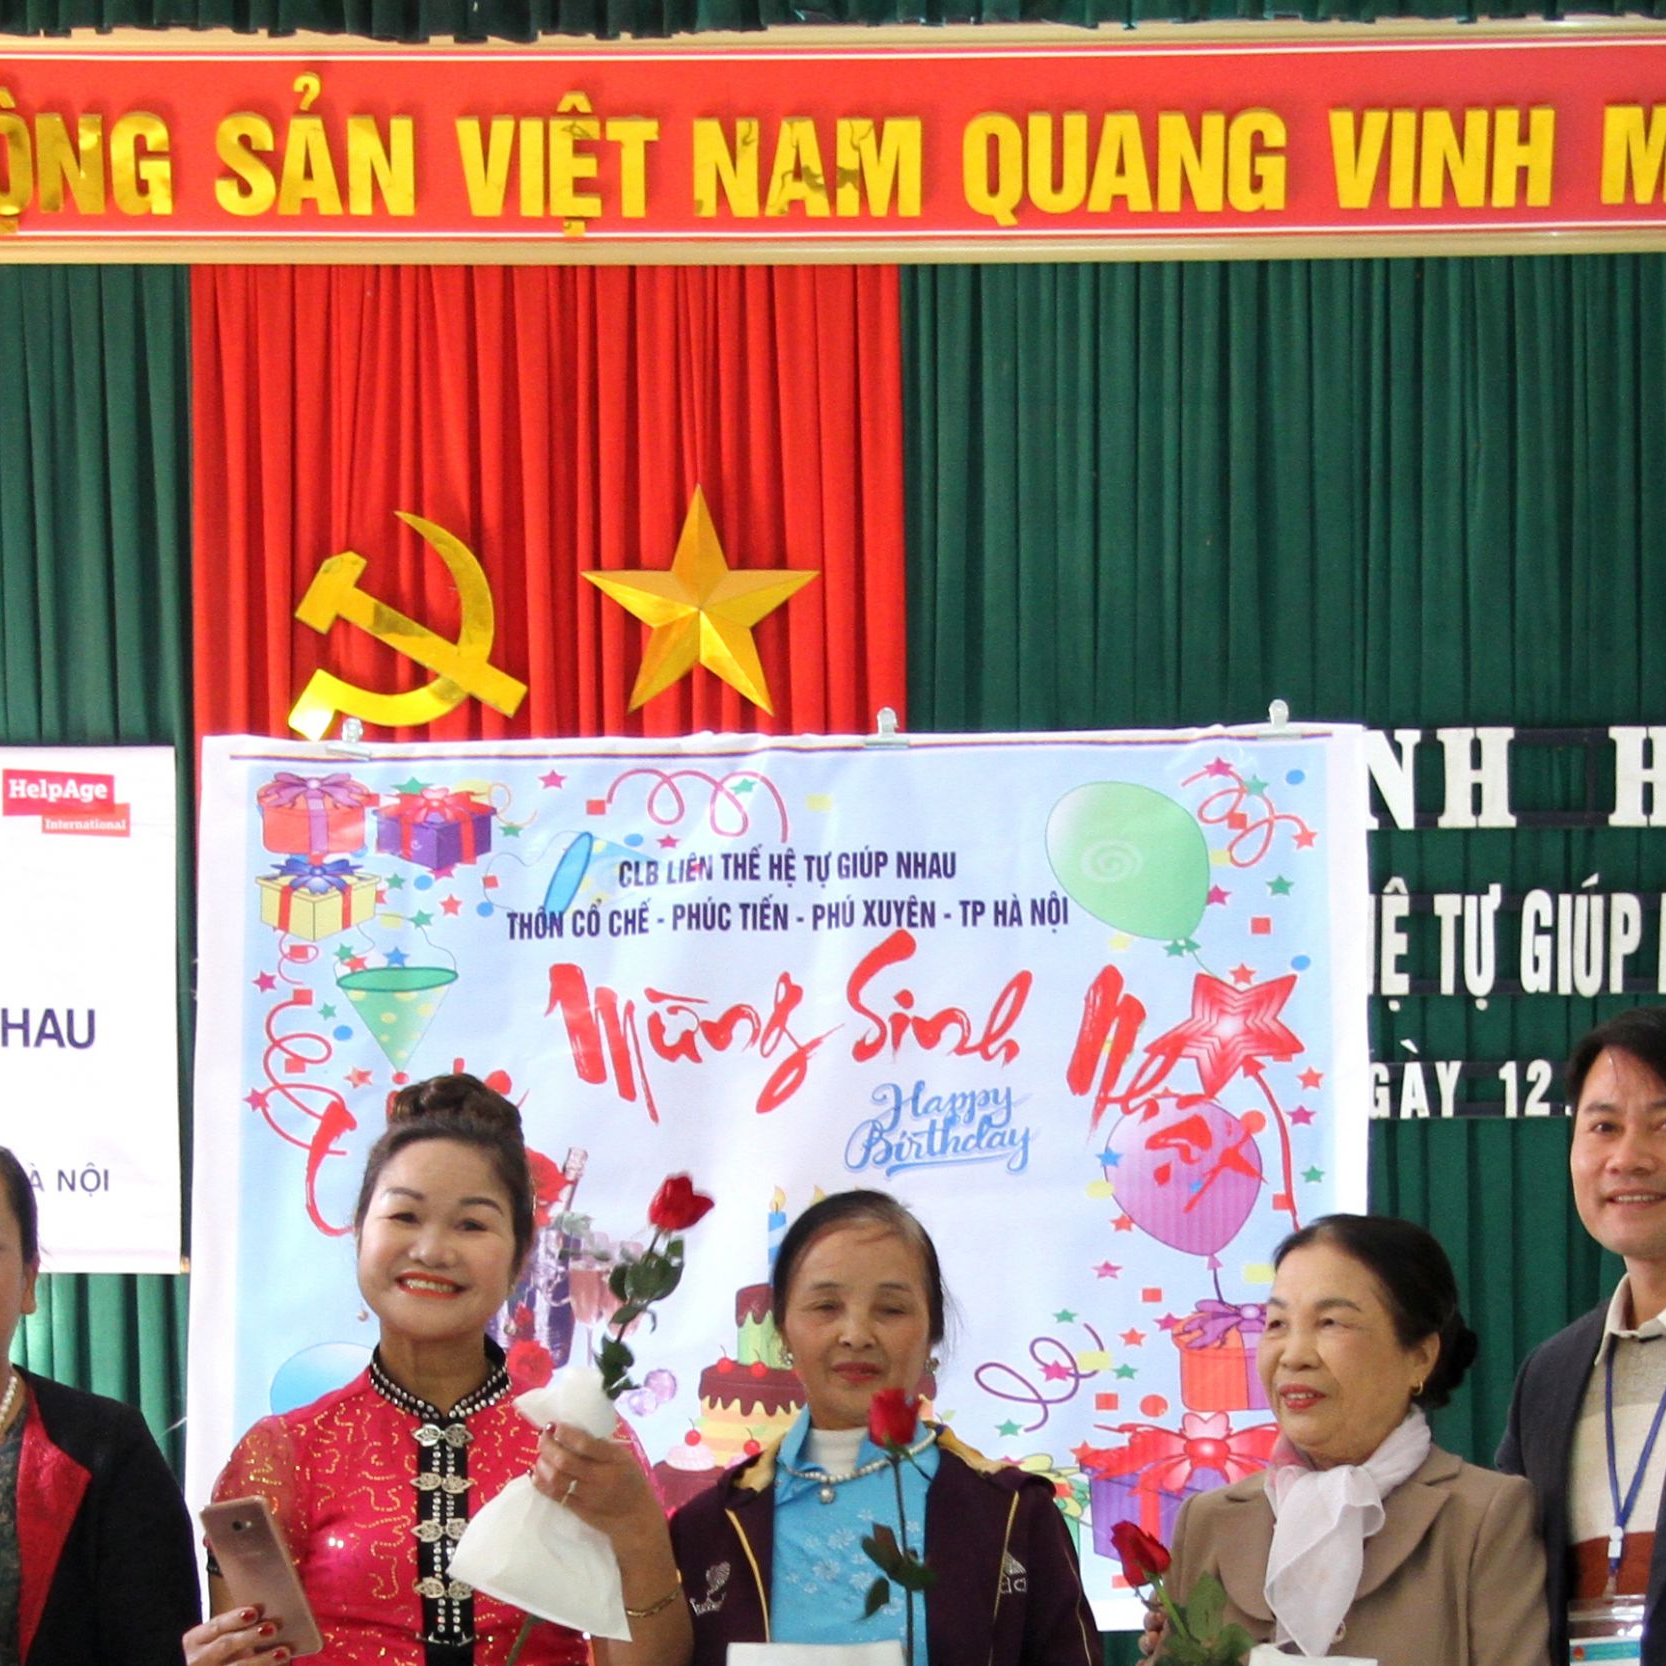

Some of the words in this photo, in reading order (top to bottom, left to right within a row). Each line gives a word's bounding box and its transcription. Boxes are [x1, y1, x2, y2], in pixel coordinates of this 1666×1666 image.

[214, 71, 416, 217] SẢN
[454, 90, 660, 236] VIỆT
[693, 115, 923, 218] NAM
[962, 107, 1287, 226] QUANG
[1328, 105, 1555, 209] VINH
[8, 778, 109, 802] HelpAge
[1363, 726, 1518, 830] NH
[44, 818, 128, 832] International
[618, 859, 659, 888] CLB
[666, 856, 713, 885] LIÊN
[720, 843, 763, 881] THẾ
[768, 849, 797, 888] HỆ
[804, 851, 834, 889] TỰ
[837, 844, 888, 880] GIÚP
[896, 851, 957, 880] NHAU
[507, 905, 564, 941] THÔN
[571, 897, 604, 938] CỔ
[609, 896, 651, 937] CHẾ
[672, 896, 733, 932] PHÚC
[739, 893, 788, 931] TIẾN
[812, 895, 855, 930] PHÚ
[863, 894, 935, 929] XUYÊN
[959, 900, 987, 928] TP
[993, 892, 1023, 927] HÀ
[1031, 891, 1070, 933] NỘI
[1367, 876, 1411, 1012] Ệ
[1433, 883, 1502, 1011] TỰ
[1520, 872, 1642, 998] GIÚP
[846, 929, 1033, 1067] Sinh
[872, 1080, 1013, 1134] Happy
[1369, 1039, 1462, 1119] GÀY
[845, 1117, 1031, 1177] Birthday
[56, 1163, 110, 1195] NỘI
